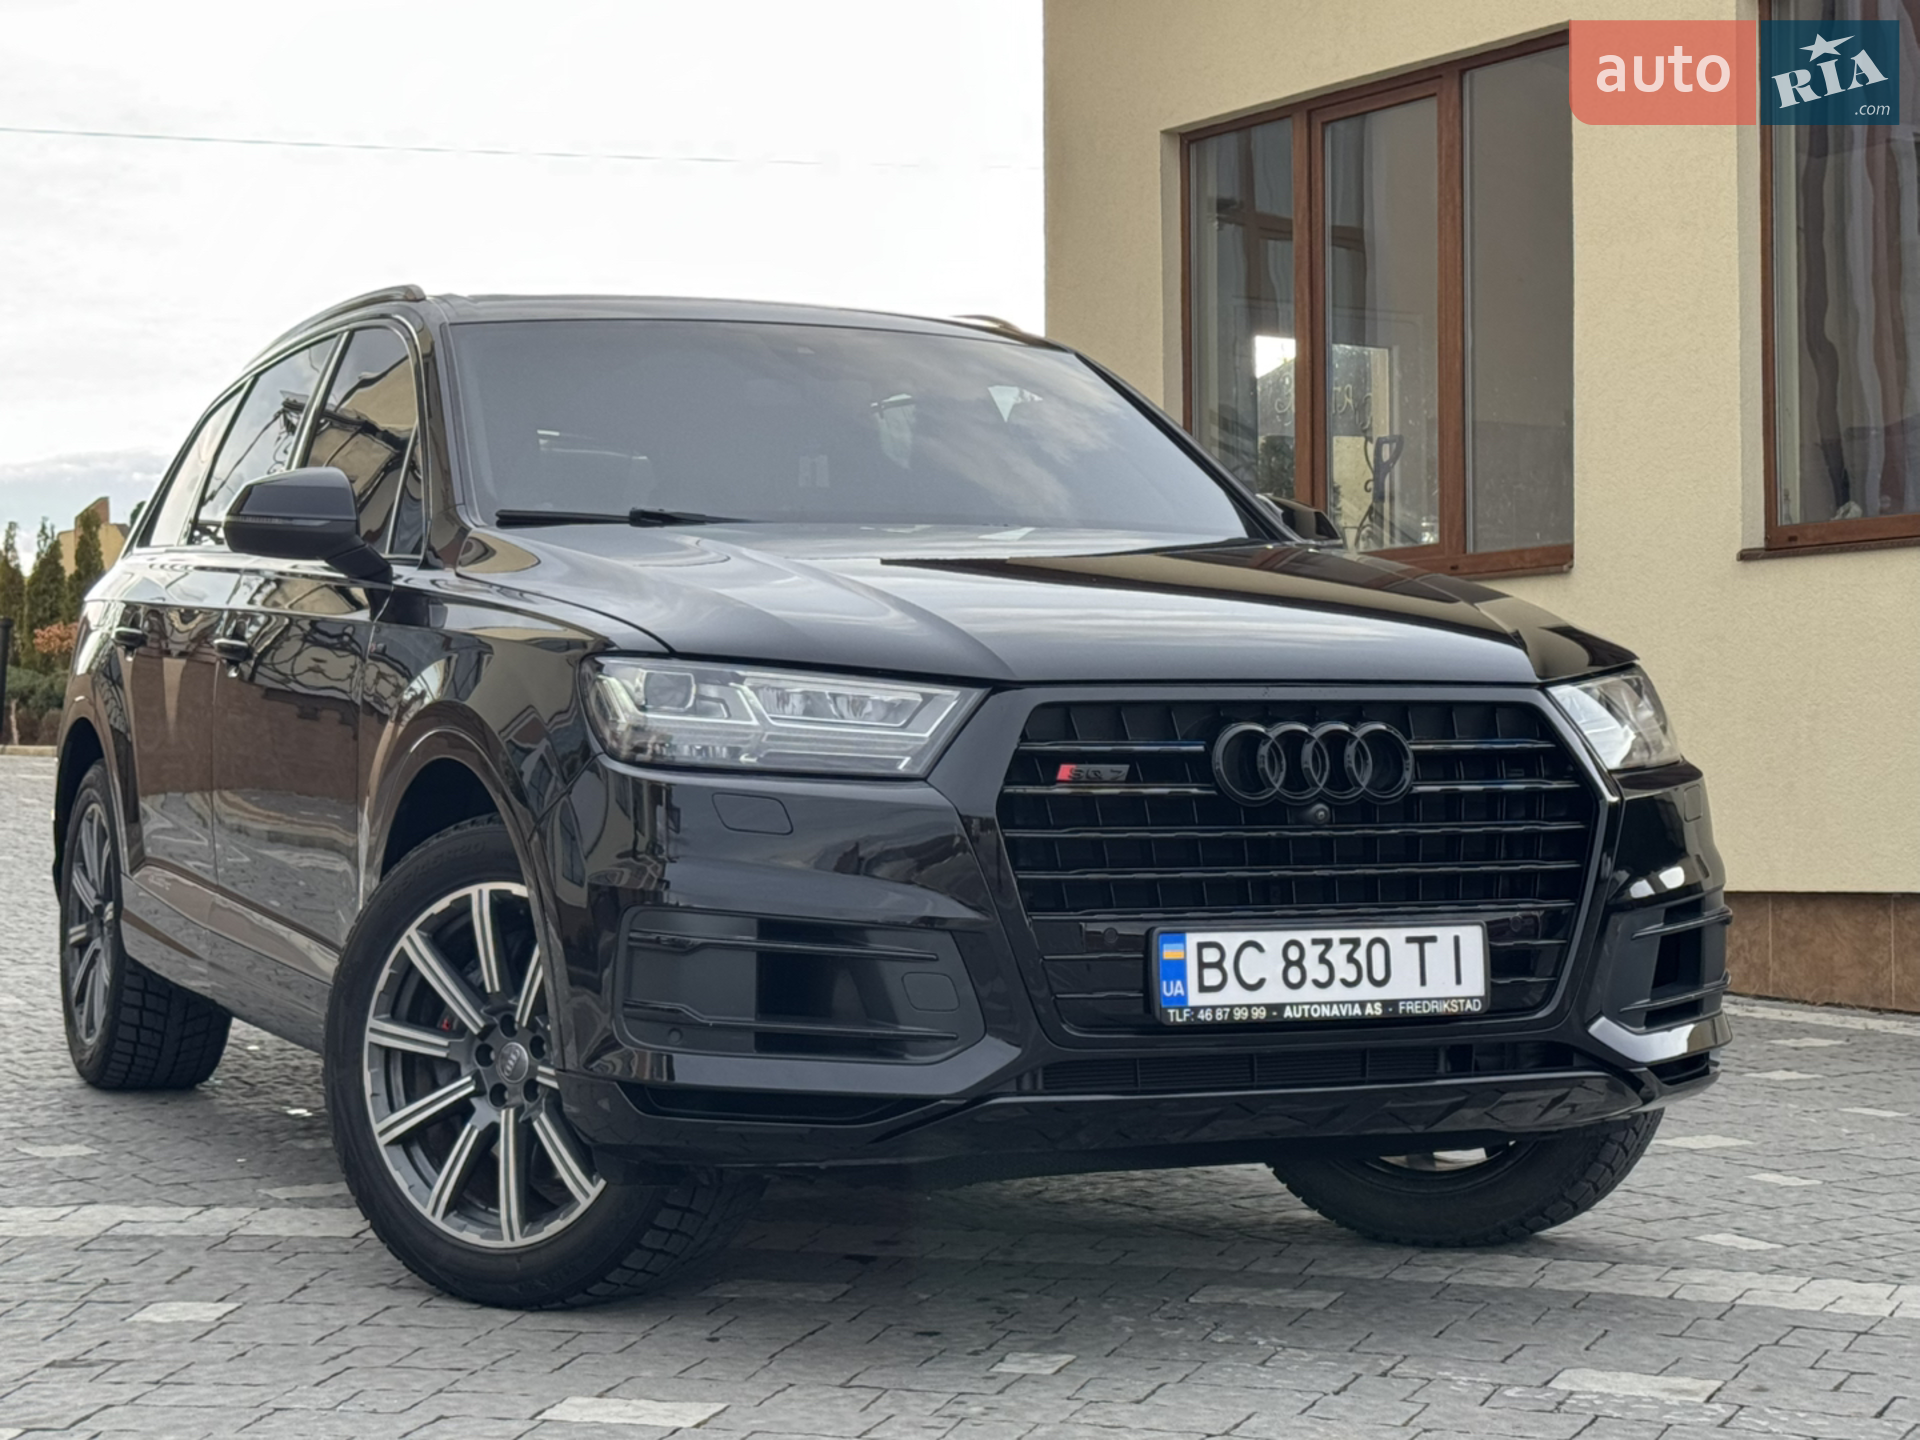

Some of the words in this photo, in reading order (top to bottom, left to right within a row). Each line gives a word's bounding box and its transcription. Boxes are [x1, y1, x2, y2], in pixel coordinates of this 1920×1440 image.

[1196, 940, 1267, 994] BC
[1281, 936, 1392, 990] 8330
[1405, 935, 1462, 987] TI
[1162, 980, 1185, 997] UA
[1167, 1009, 1195, 1022] TLF:
[1197, 1008, 1213, 1021] 46
[1215, 1008, 1230, 1021] 87
[1232, 1007, 1248, 1020] 99
[1251, 1006, 1266, 1020] 99
[1283, 1003, 1362, 1019] AUTONAVIA
[1364, 1002, 1383, 1016] AS
[1398, 999, 1482, 1014] FREDRIKSTAD
